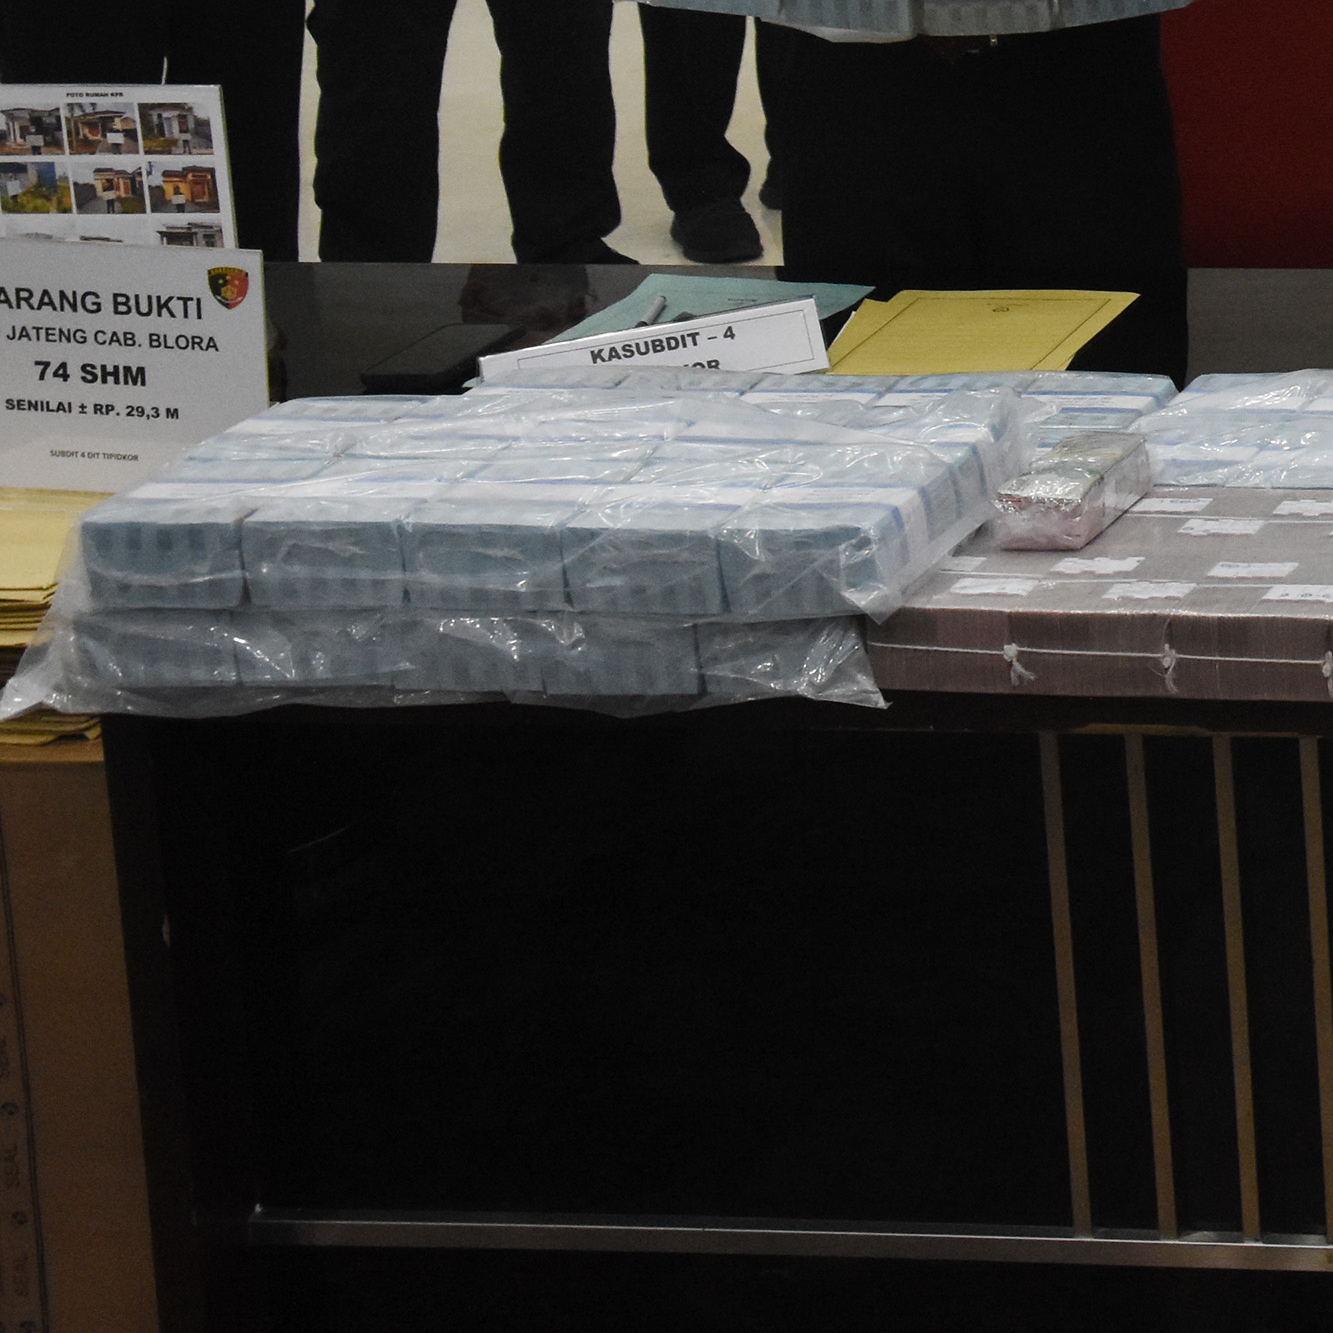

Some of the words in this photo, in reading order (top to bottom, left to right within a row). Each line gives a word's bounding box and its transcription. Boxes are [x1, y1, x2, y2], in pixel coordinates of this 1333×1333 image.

[0, 287, 101, 314] ARANG
[113, 293, 202, 319] BUKTI
[7, 326, 87, 344] JATENG
[94, 330, 141, 347] CAB.
[149, 333, 219, 351] BLORA
[590, 332, 701, 365] KASUBDIT
[724, 326, 735, 339] 4
[35, 361, 70, 382] 74
[81, 363, 146, 386] SHM
[6, 399, 72, 413] SENILAI
[79, 403, 87, 414] ±
[94, 404, 119, 416] RP.
[126, 405, 160, 420] 29,3
[166, 408, 178, 419] M
[50, 449, 78, 457] SUBDIT
[102, 453, 139, 461] TIPIDKOR
